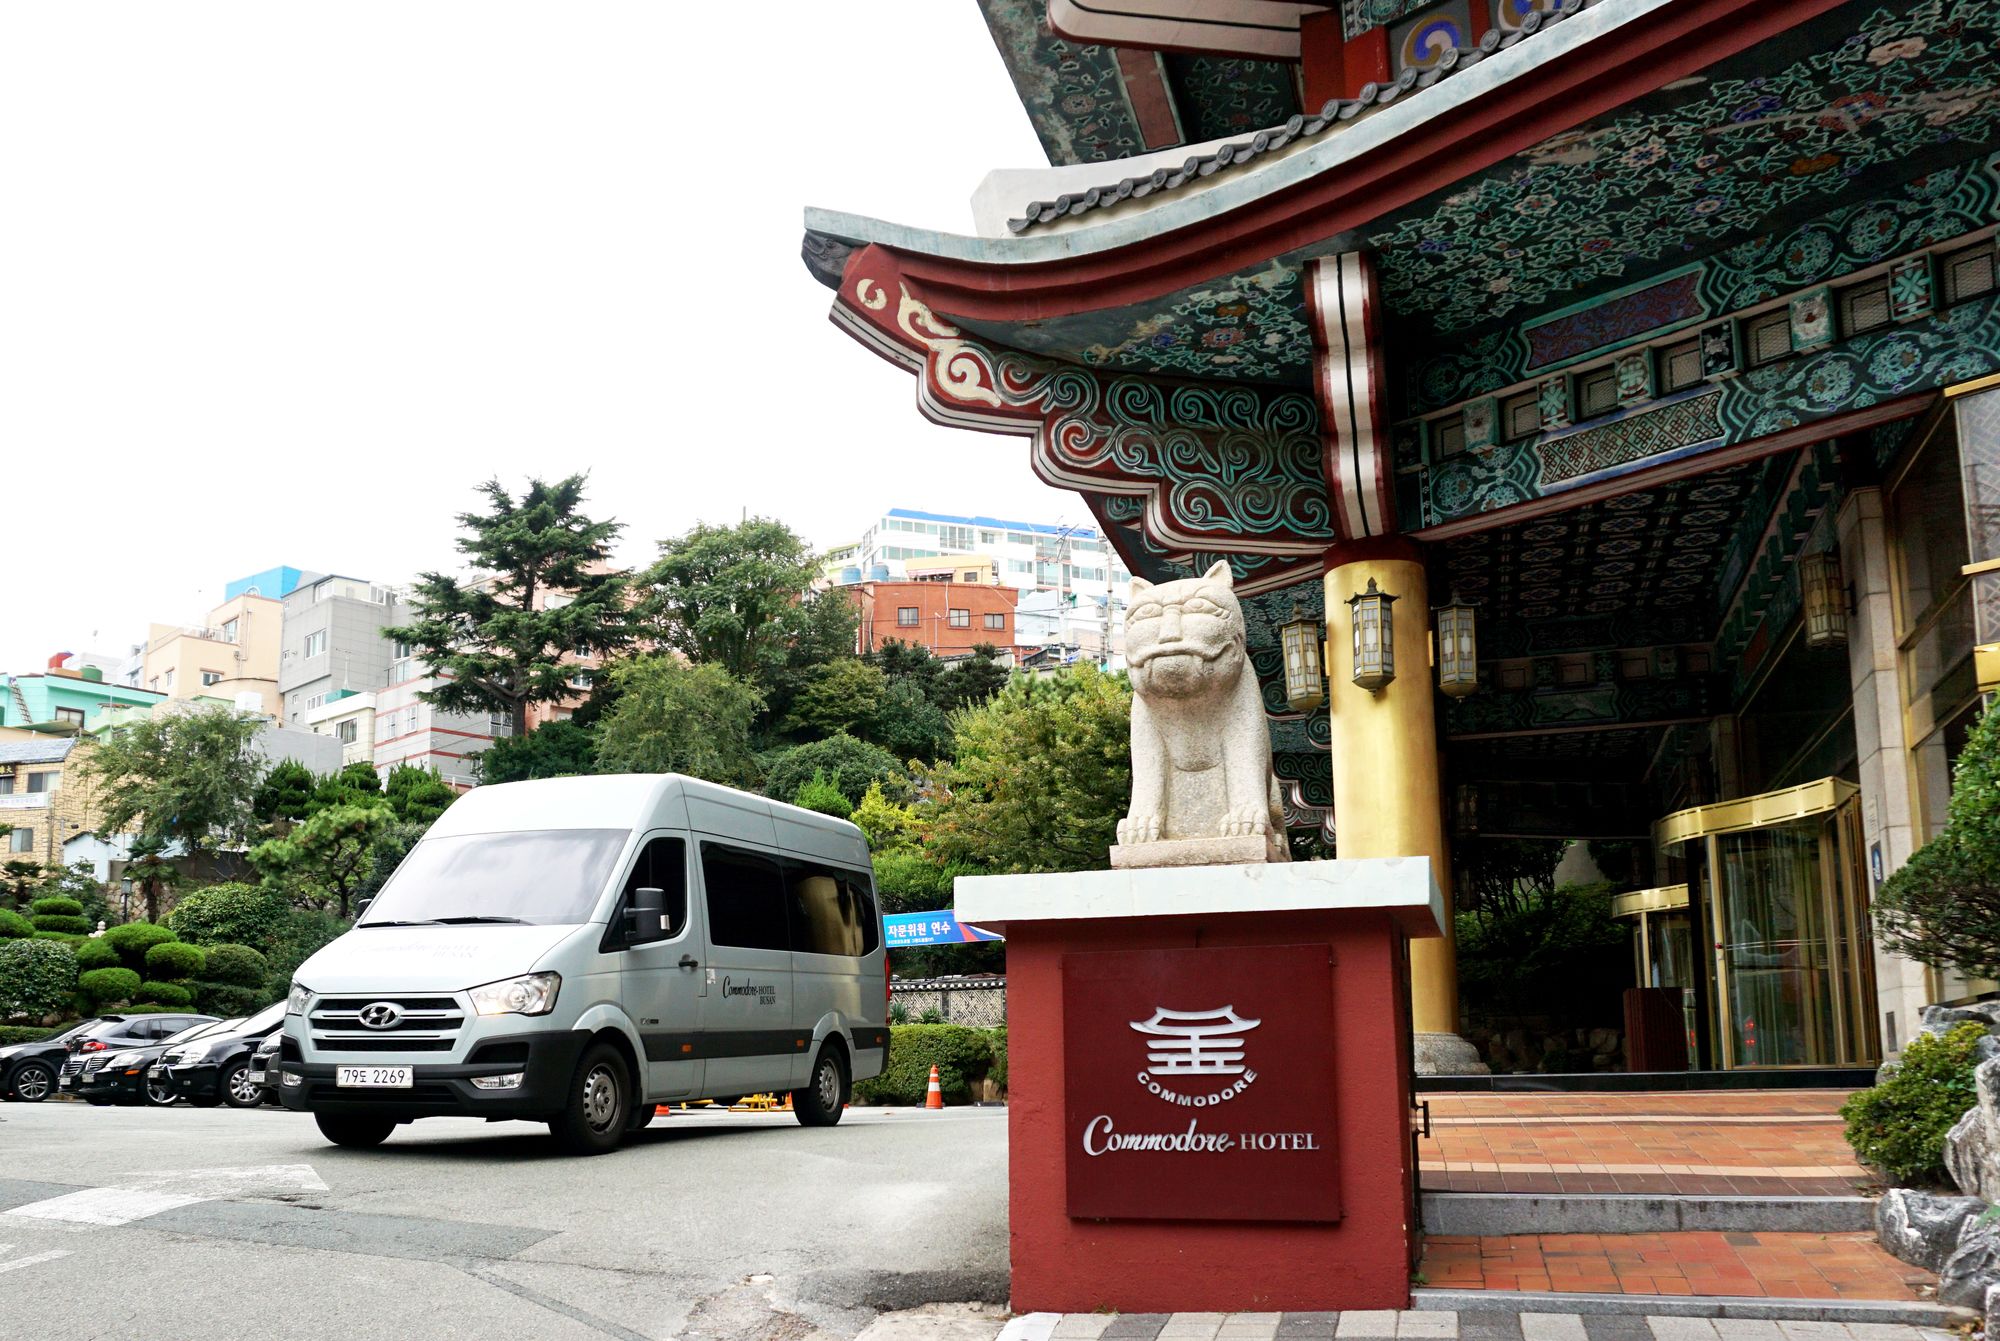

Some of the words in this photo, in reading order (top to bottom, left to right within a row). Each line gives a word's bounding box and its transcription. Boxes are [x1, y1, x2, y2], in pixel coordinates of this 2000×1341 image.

[888, 922, 926, 938] 자문위원
[931, 921, 951, 935] 연수
[758, 985, 775, 995] HOTEL
[760, 995, 776, 1005] BUSAN
[344, 1070, 366, 1083] 79도
[374, 1070, 405, 1083] 2269
[1137, 1068, 1258, 1107] COMMODORE
[1083, 1115, 1236, 1156] Commodore
[1240, 1132, 1320, 1151] HOTEL
